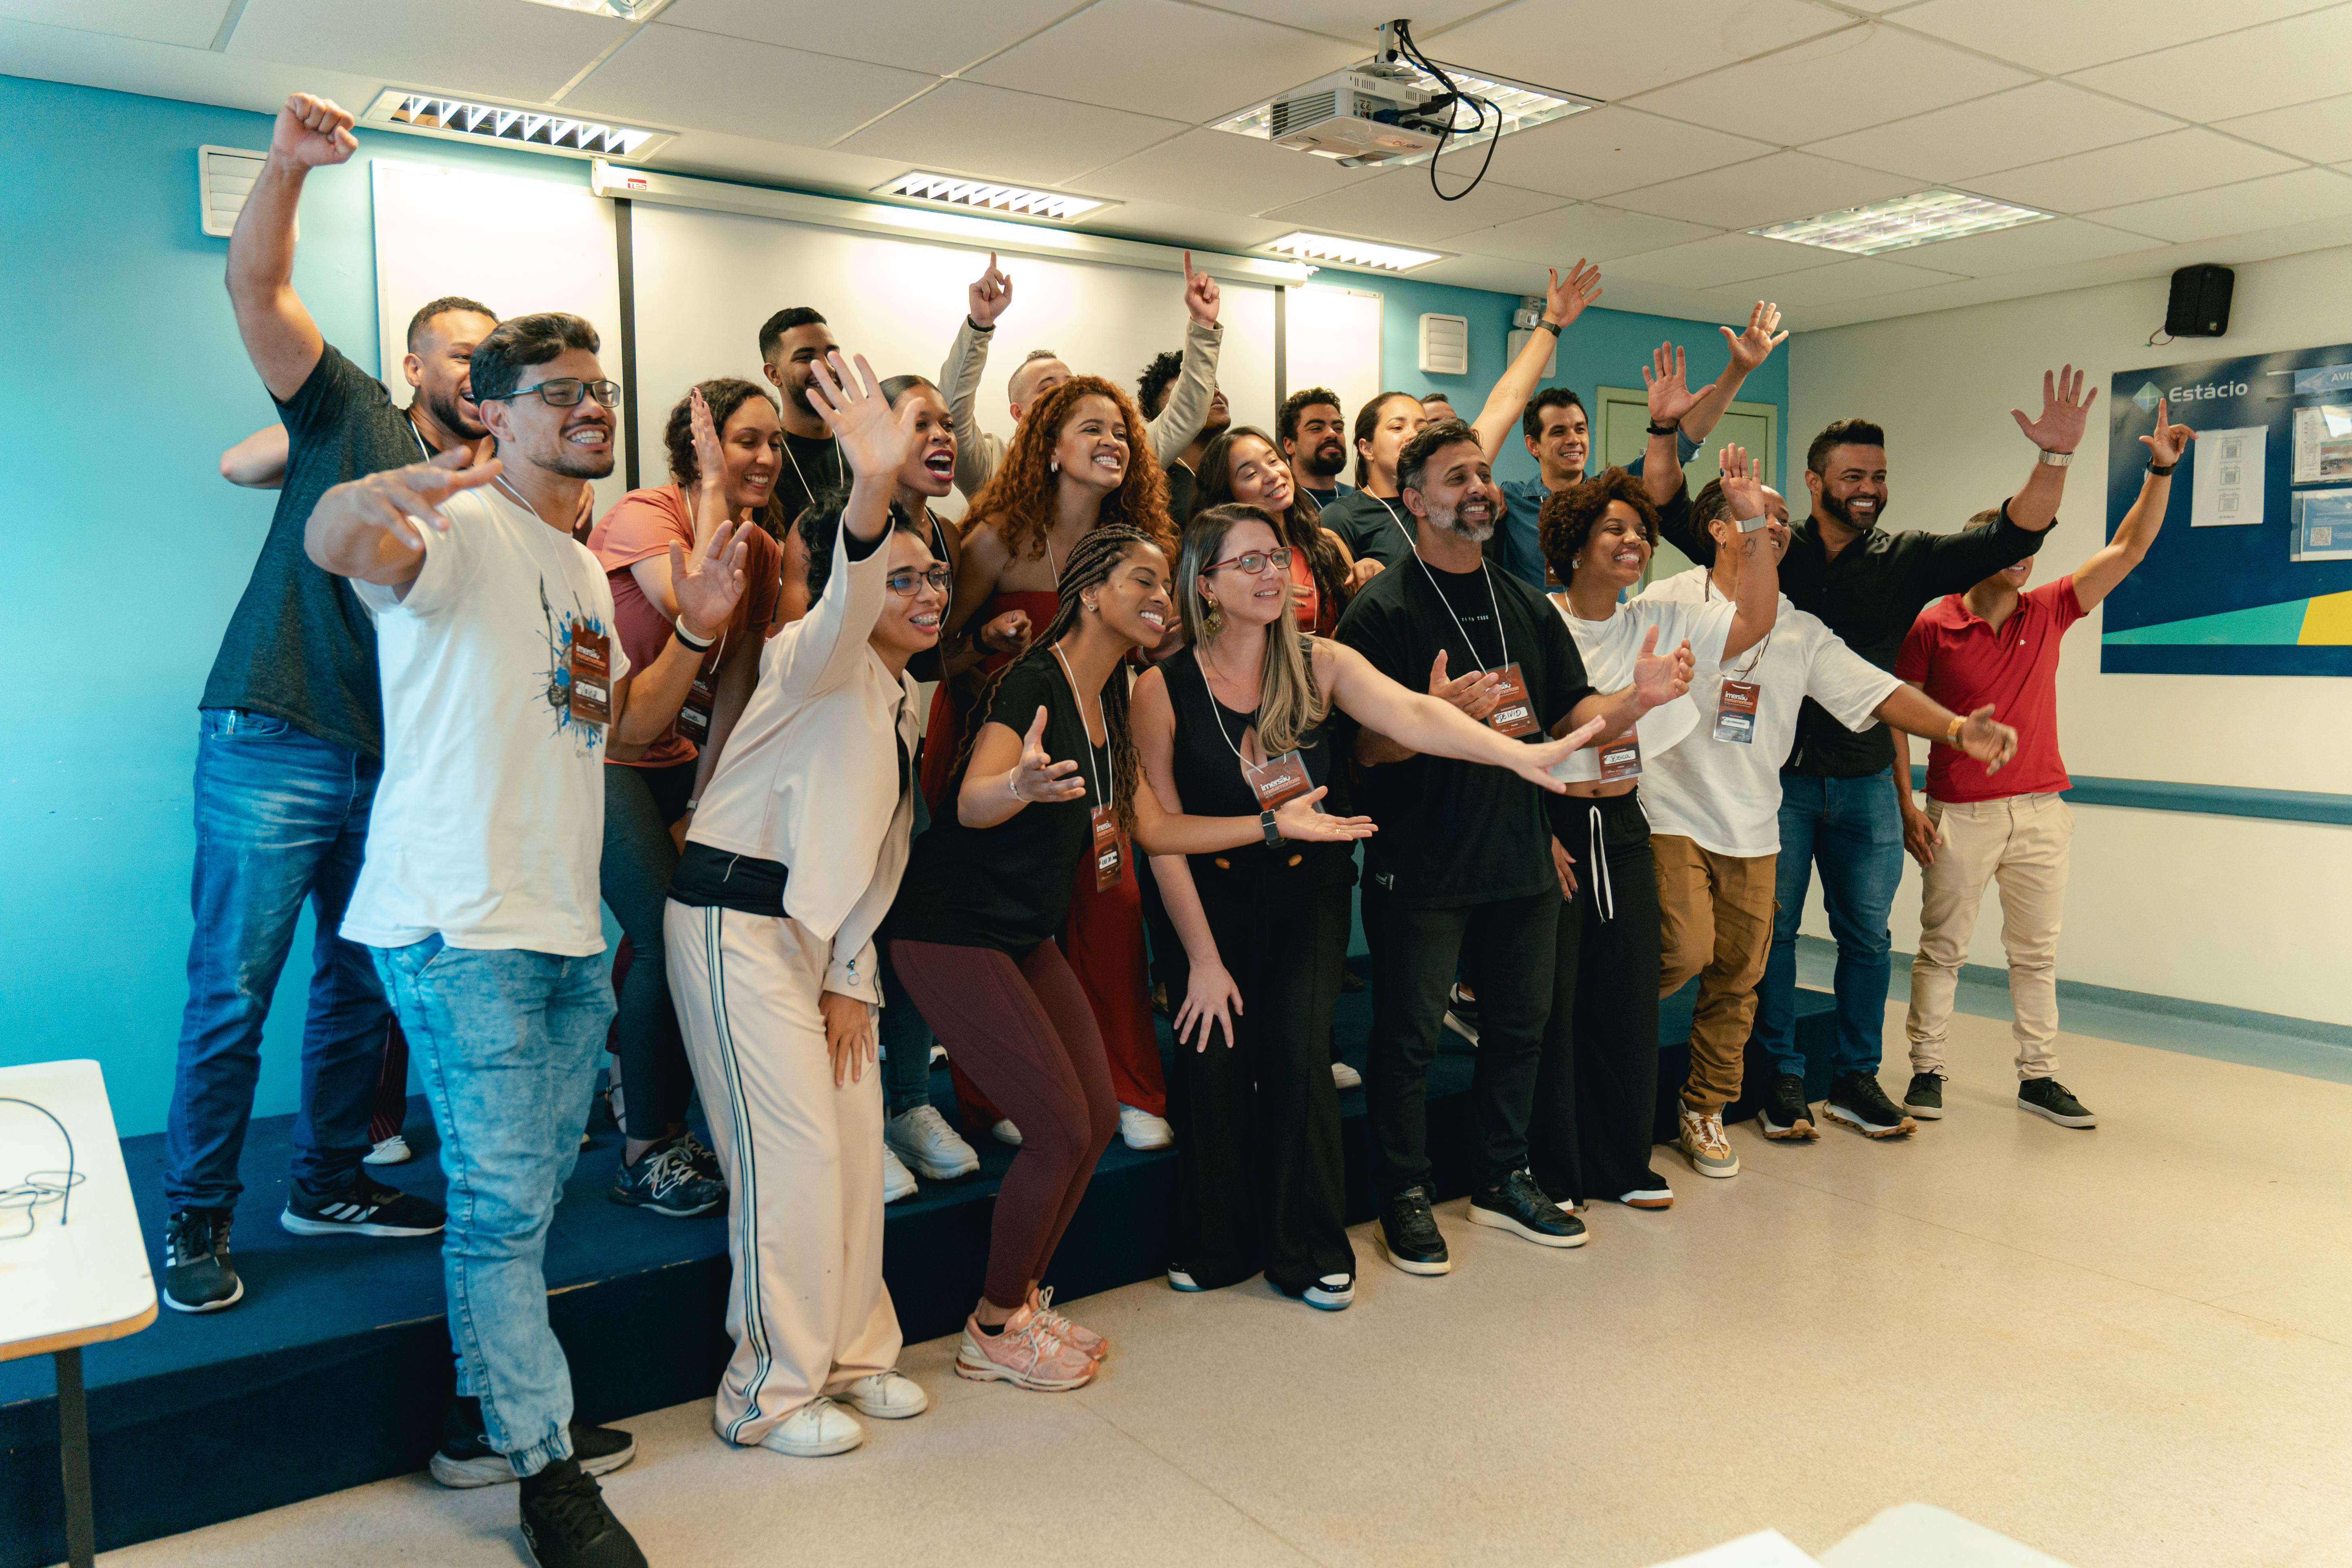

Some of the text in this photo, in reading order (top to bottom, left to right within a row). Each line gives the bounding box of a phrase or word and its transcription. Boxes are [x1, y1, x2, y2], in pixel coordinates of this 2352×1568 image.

[1392, 140, 1423, 149] BenQ
[627, 181, 647, 190] TES
[2169, 380, 2248, 402] Estácio
[1725, 691, 1748, 701] imersão
[1260, 775, 1291, 792] imersão
